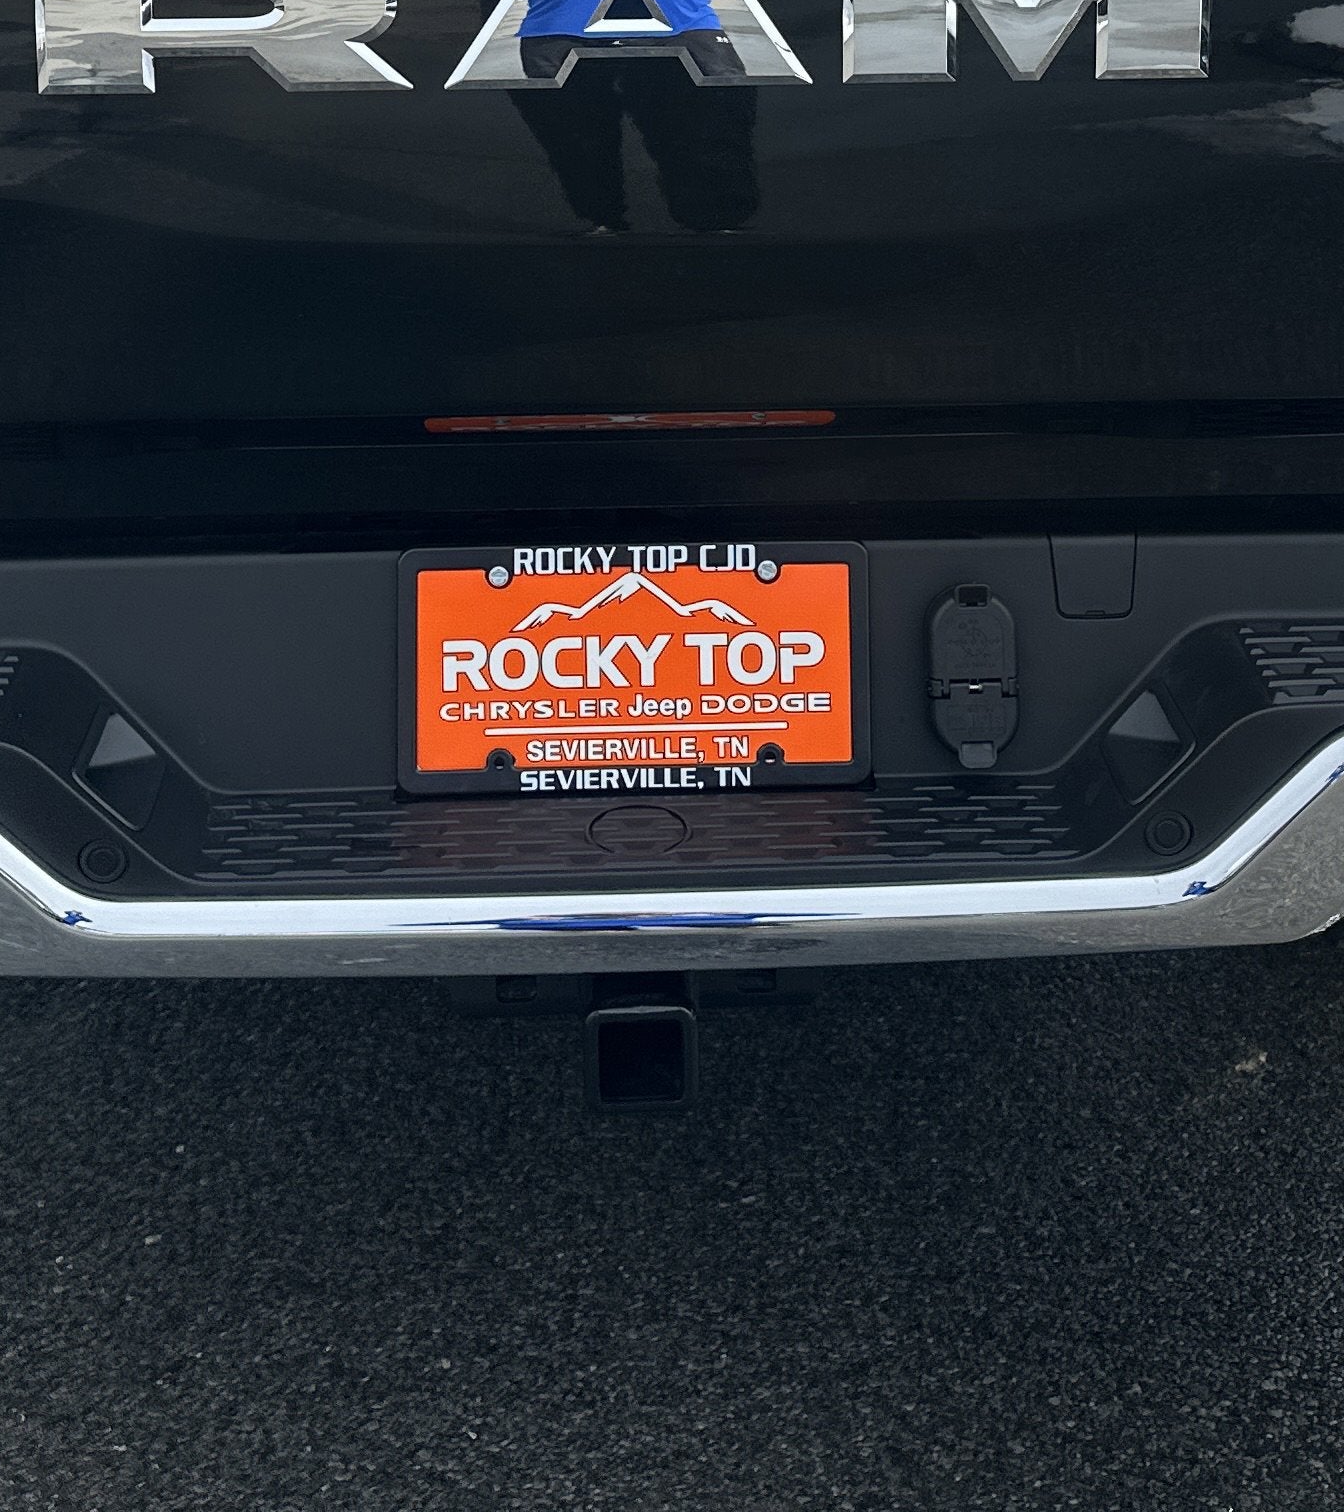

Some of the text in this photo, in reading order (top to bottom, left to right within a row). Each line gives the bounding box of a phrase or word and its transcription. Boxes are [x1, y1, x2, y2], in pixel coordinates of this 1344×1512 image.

[513, 544, 756, 575] ROCKY TOP CJD
[440, 631, 826, 692] ROCKY TOP
[439, 692, 831, 722] CHRYSLER Jeep DODGE
[525, 736, 750, 763] SEVIERVILLE, TN
[520, 766, 752, 791] SEVIERVILLE, TN
